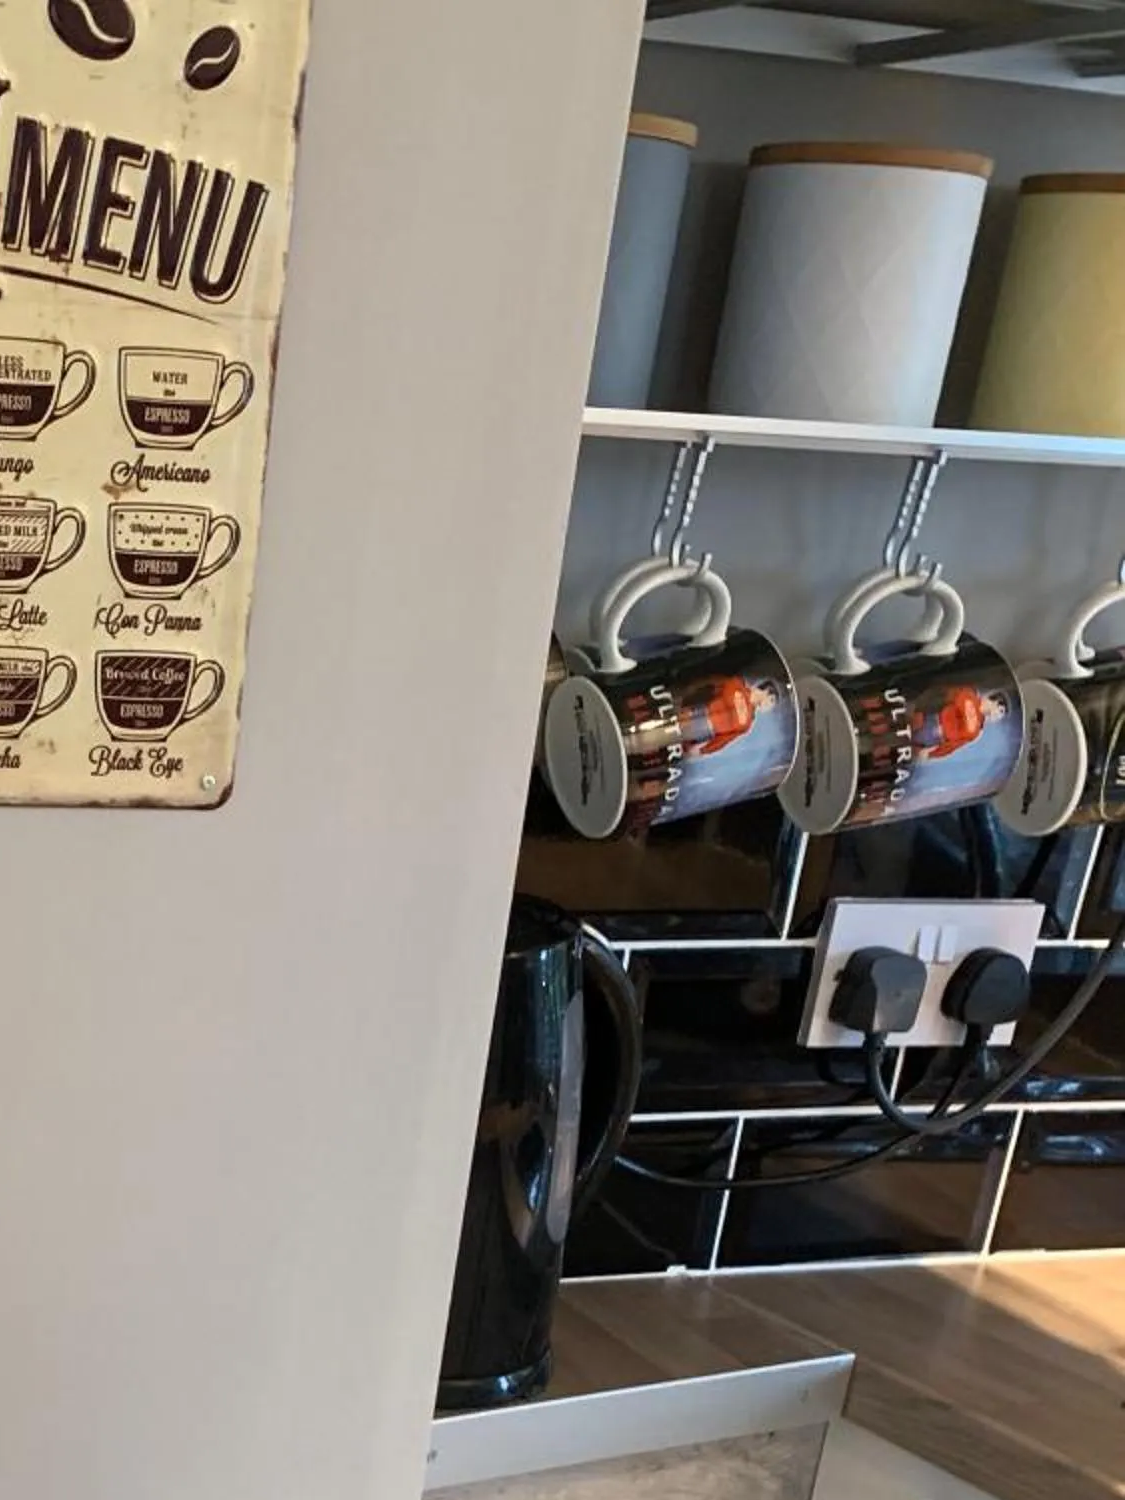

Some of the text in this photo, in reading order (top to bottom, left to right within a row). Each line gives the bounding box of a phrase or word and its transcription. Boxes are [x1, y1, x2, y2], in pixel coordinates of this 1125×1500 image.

[1, 115, 270, 304] MENU
[152, 371, 188, 385] WATER
[144, 406, 191, 425] ESPRESSO
[110, 453, 211, 492] Americano
[13, 524, 39, 538] MILK
[134, 559, 179, 575] ESPRESSO
[96, 602, 203, 639] Con Panna
[120, 703, 165, 719] ESPRESSO
[88, 745, 185, 779] Black Eye
